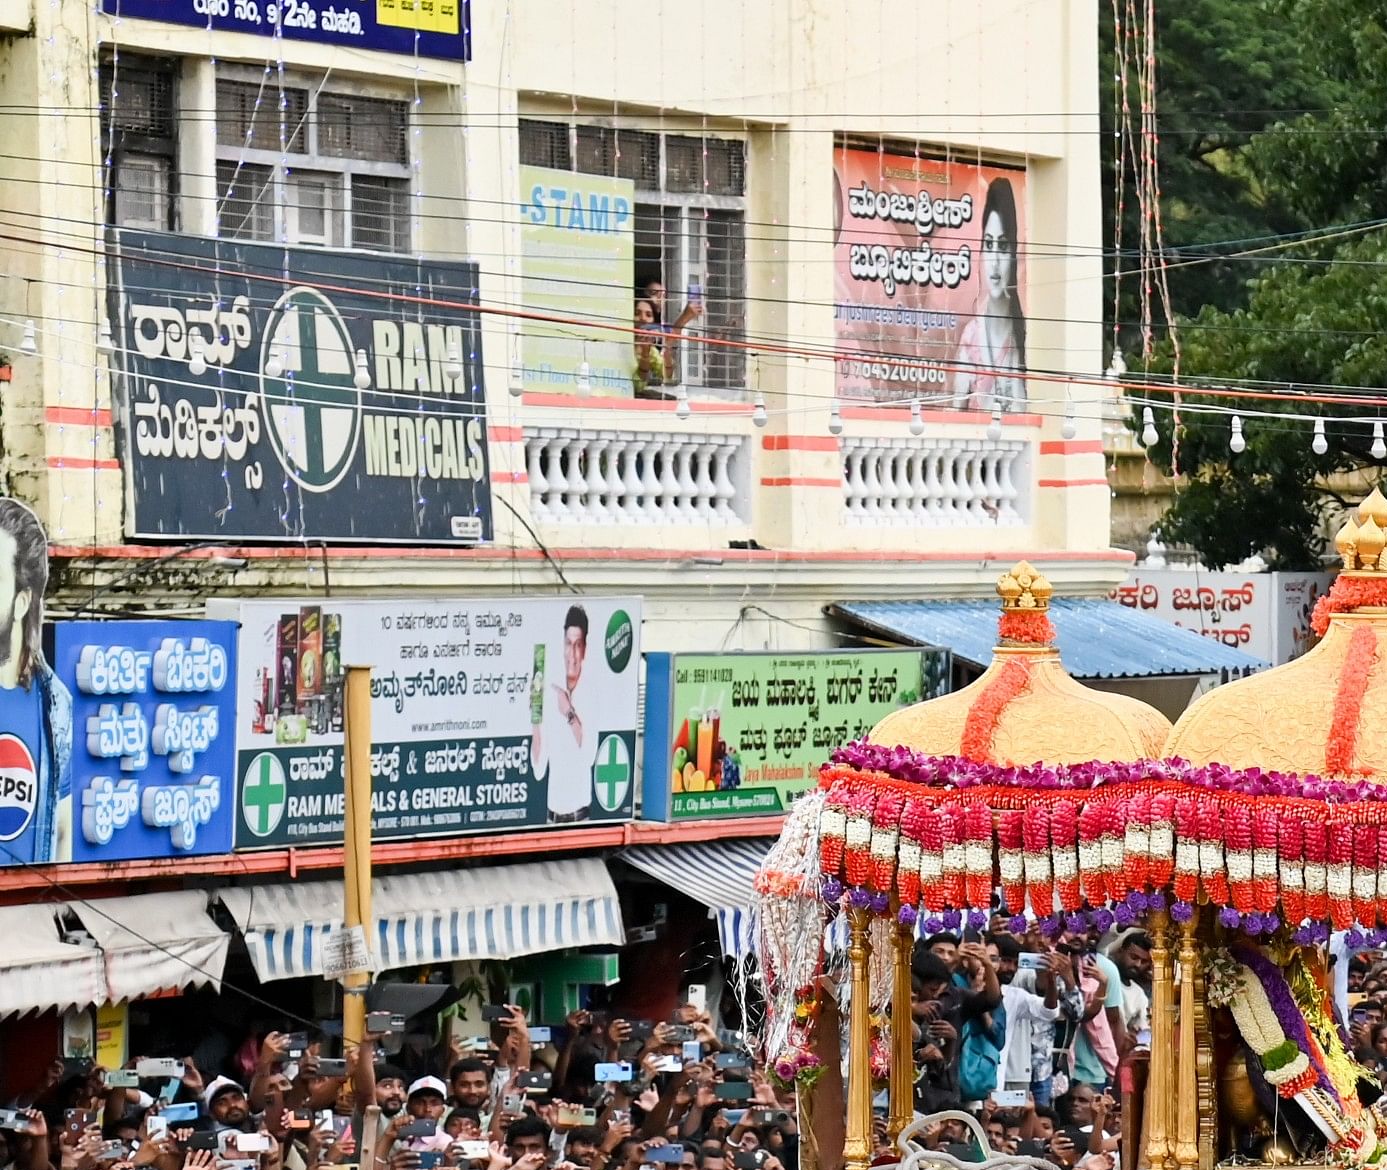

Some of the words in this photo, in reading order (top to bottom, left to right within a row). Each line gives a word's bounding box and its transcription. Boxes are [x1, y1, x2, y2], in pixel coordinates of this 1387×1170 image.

[131, 295, 252, 364] ರಾಮ್
[372, 320, 467, 395] RAM
[134, 384, 263, 490] ಮೆಡಿಕಲ್ಸ್
[363, 415, 484, 481] MEDICALS
[732, 674, 760, 707] ಜಯ
[406, 750, 418, 775] &
[287, 795, 321, 818] RAM
[324, 790, 396, 816] MEALS
[399, 792, 410, 811] &
[412, 785, 473, 810] GENERAL
[476, 782, 528, 806] STORES
